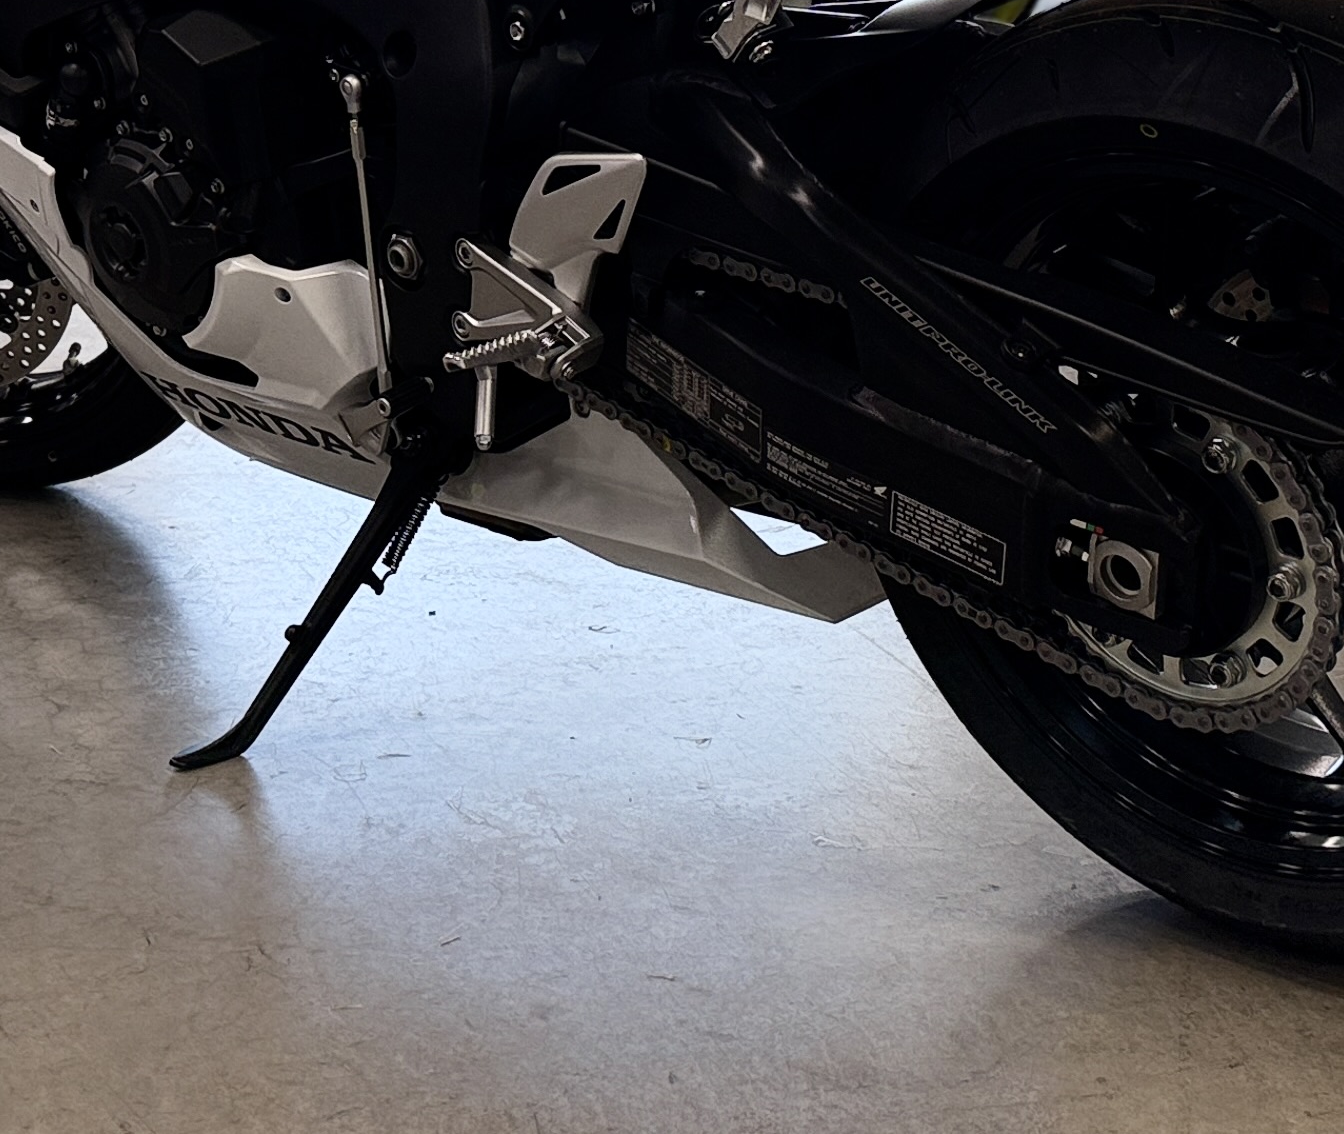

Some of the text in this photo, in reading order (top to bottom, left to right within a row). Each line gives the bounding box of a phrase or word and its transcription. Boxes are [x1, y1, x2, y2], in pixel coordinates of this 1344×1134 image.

[139, 370, 377, 465] HONDA
[859, 275, 1058, 434] UNIT PRO-LINK
